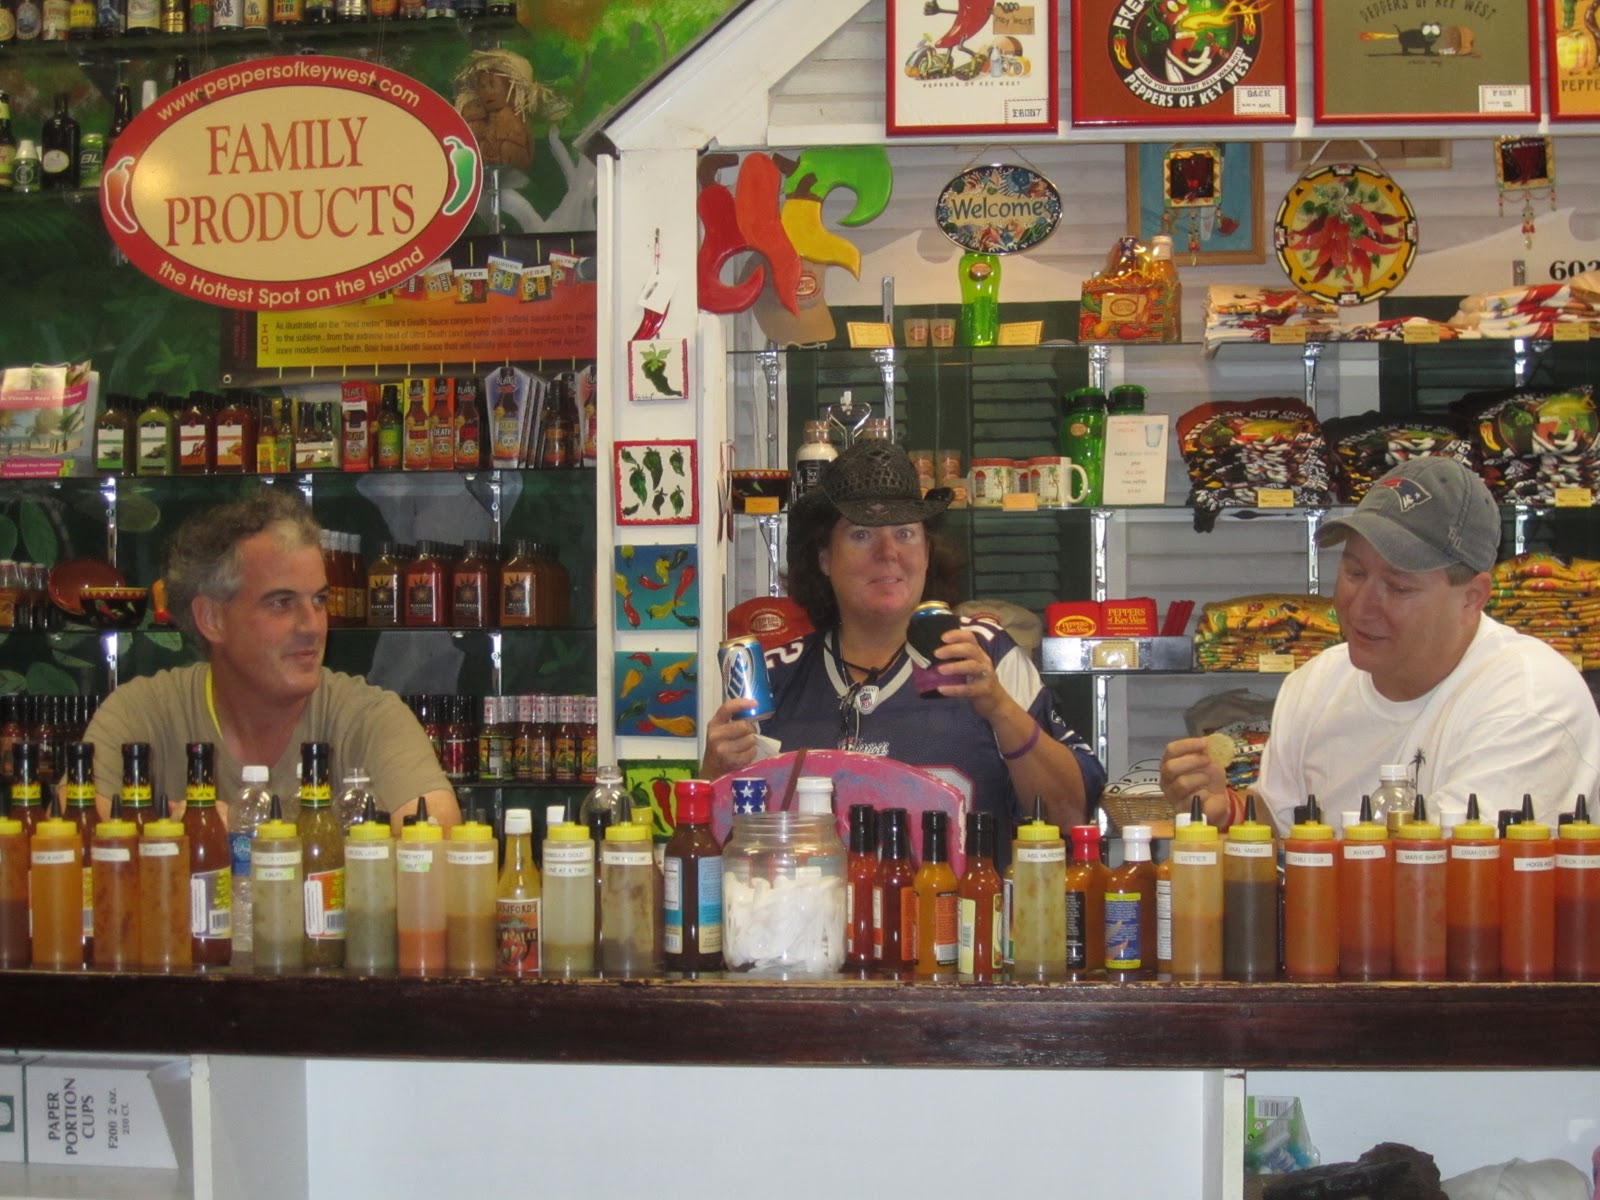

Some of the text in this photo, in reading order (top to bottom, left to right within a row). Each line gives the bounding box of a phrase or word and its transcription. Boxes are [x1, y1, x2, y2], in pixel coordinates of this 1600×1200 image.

[157, 61, 421, 122] www.peppersofkeywest.com
[1123, 52, 1253, 108] PEPPERS OF KEY WEST
[1154, 82, 1167, 92] YOU
[1169, 84, 1200, 93] THOUGHT
[207, 116, 368, 176] FAMILY
[164, 183, 416, 248] PRODUCTS
[951, 195, 1045, 221] Welcome
[158, 260, 187, 285] the
[190, 275, 254, 305] Hottest
[258, 287, 300, 308] Spot
[306, 288, 331, 302] on
[335, 276, 366, 299] the
[369, 246, 425, 288] Island
[284, 332, 295, 341] the
[1249, 409, 1279, 419] HOT
[1107, 608, 1147, 617] PEPPERS
[1114, 616, 1127, 625] Key
[1127, 616, 1147, 625] West
[108, 1087, 118, 1105] oz.
[47, 1091, 61, 1142] PAPER
[64, 1077, 79, 1156] PORTION
[81, 1094, 96, 1140] CUPS
[122, 1118, 131, 1136] 250
[108, 1122, 119, 1150] F200
